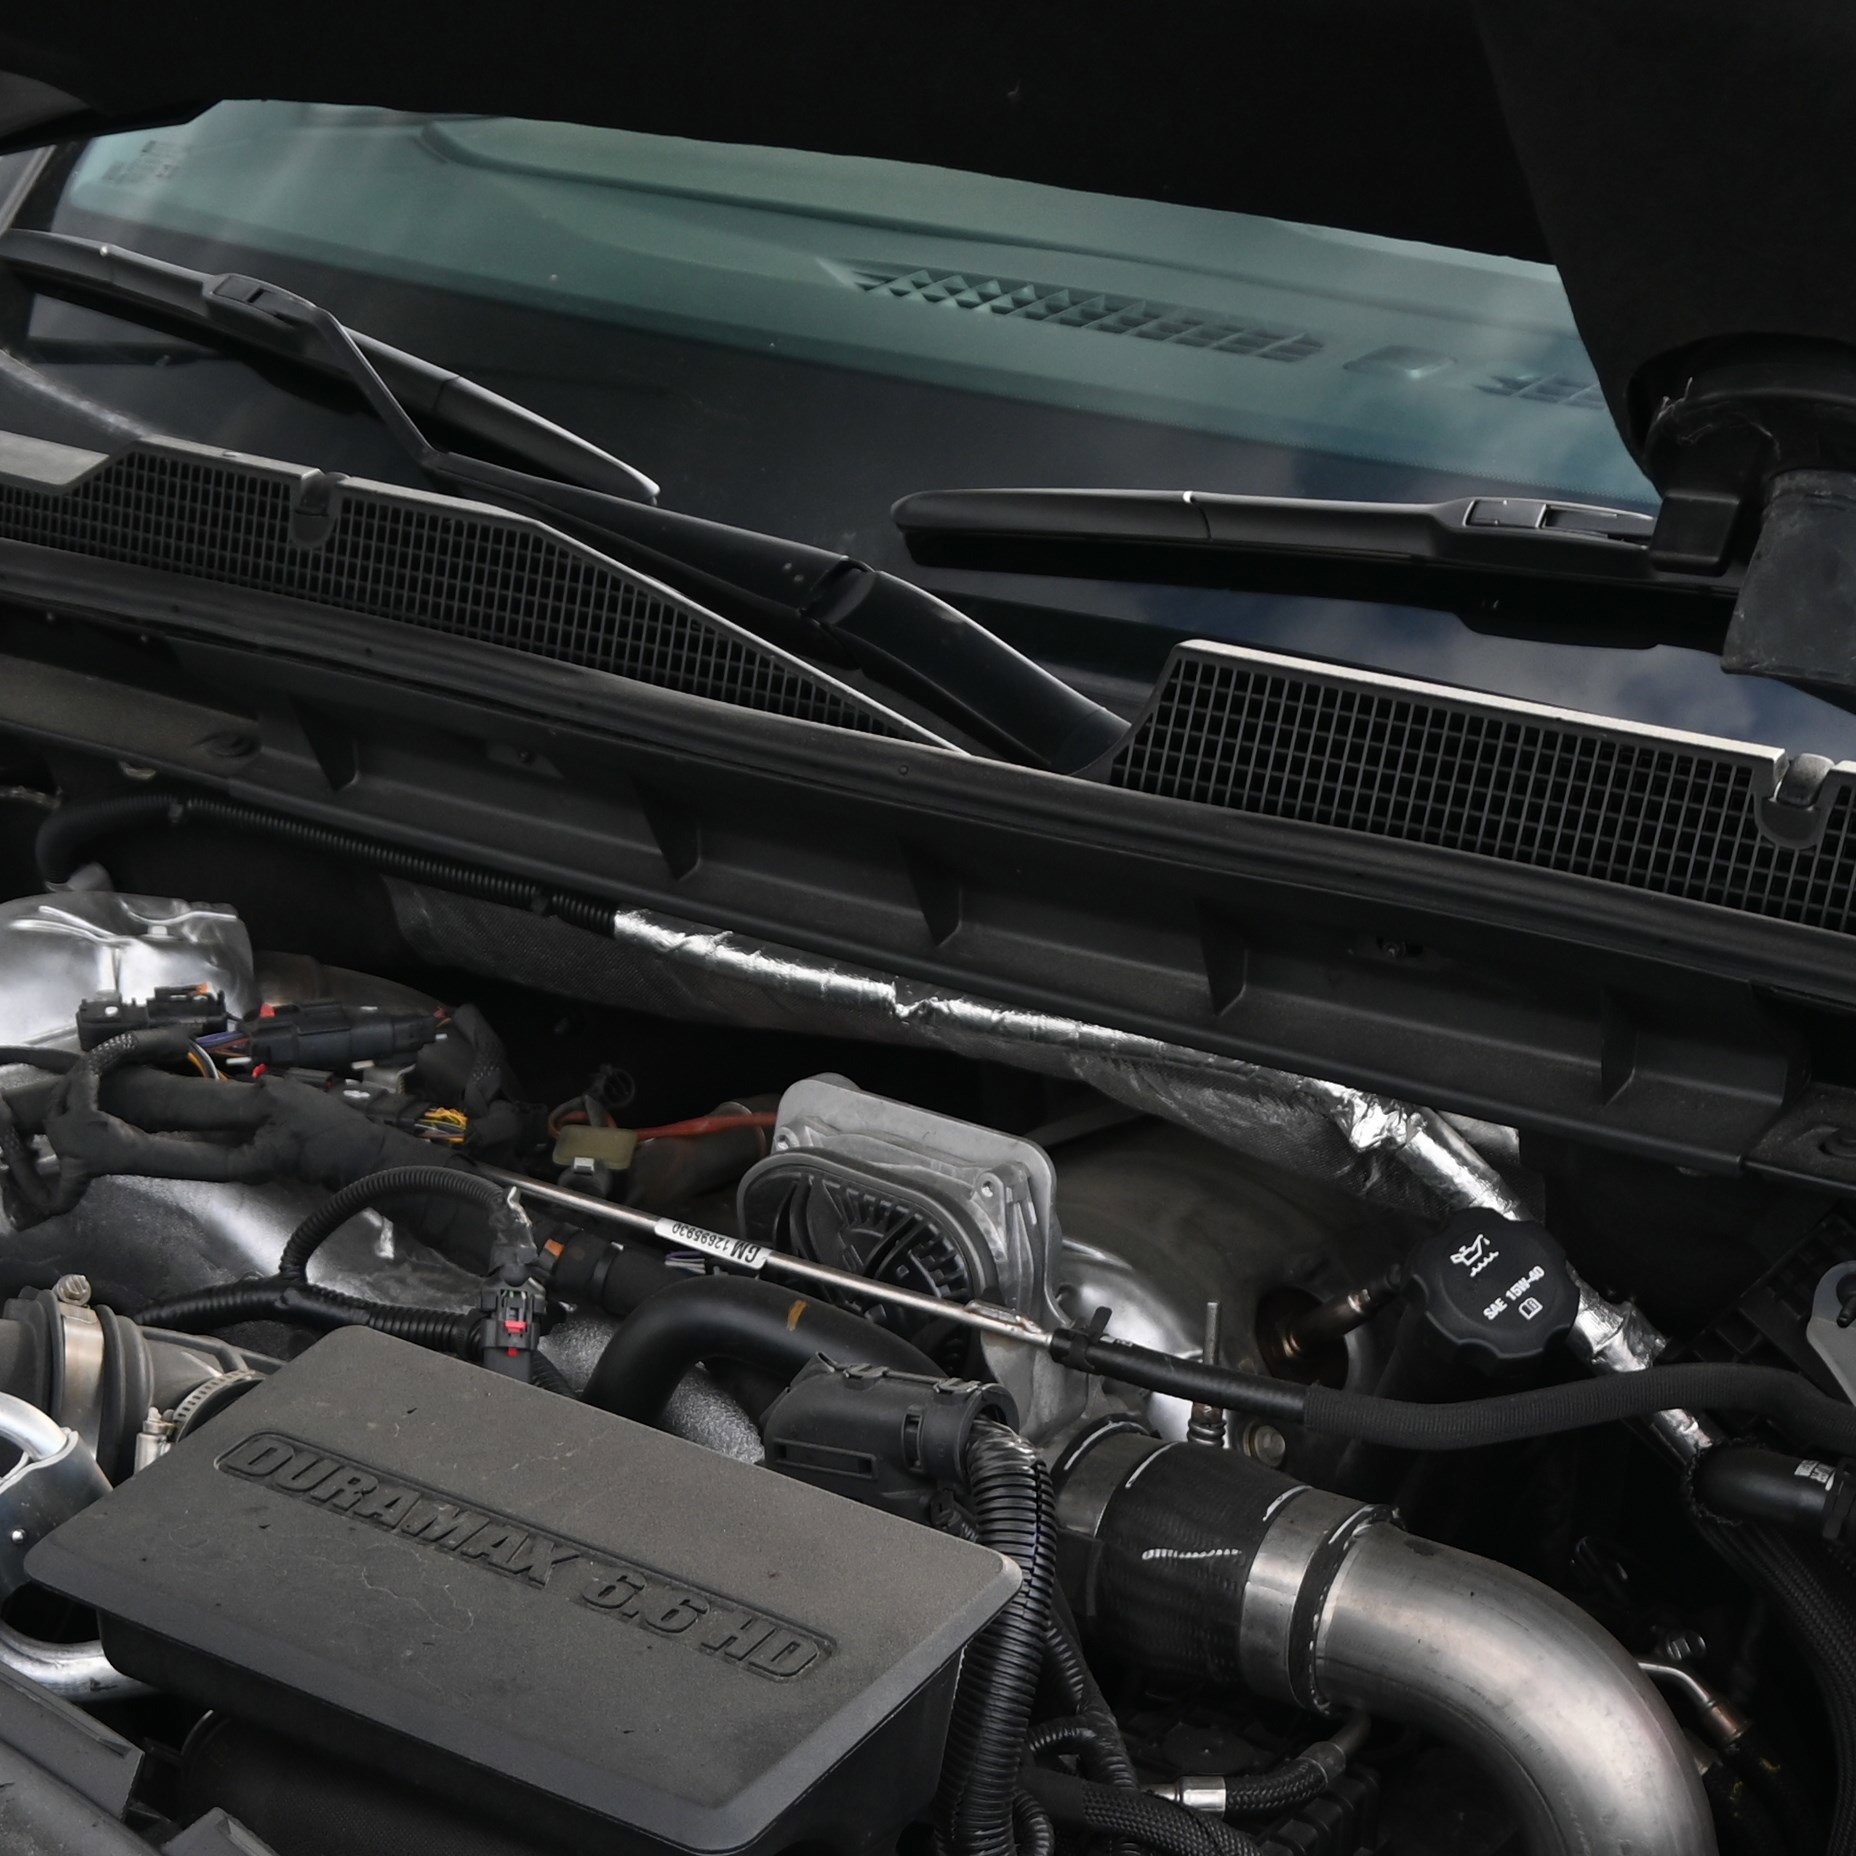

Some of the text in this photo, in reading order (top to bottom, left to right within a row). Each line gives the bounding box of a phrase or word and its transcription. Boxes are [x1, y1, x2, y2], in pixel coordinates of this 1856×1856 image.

[672, 1222, 762, 1263] GM 12695930
[1483, 1265, 1545, 1320] SAE 15W-40
[236, 1436, 821, 1680] DURAMAX 6.6 HD
